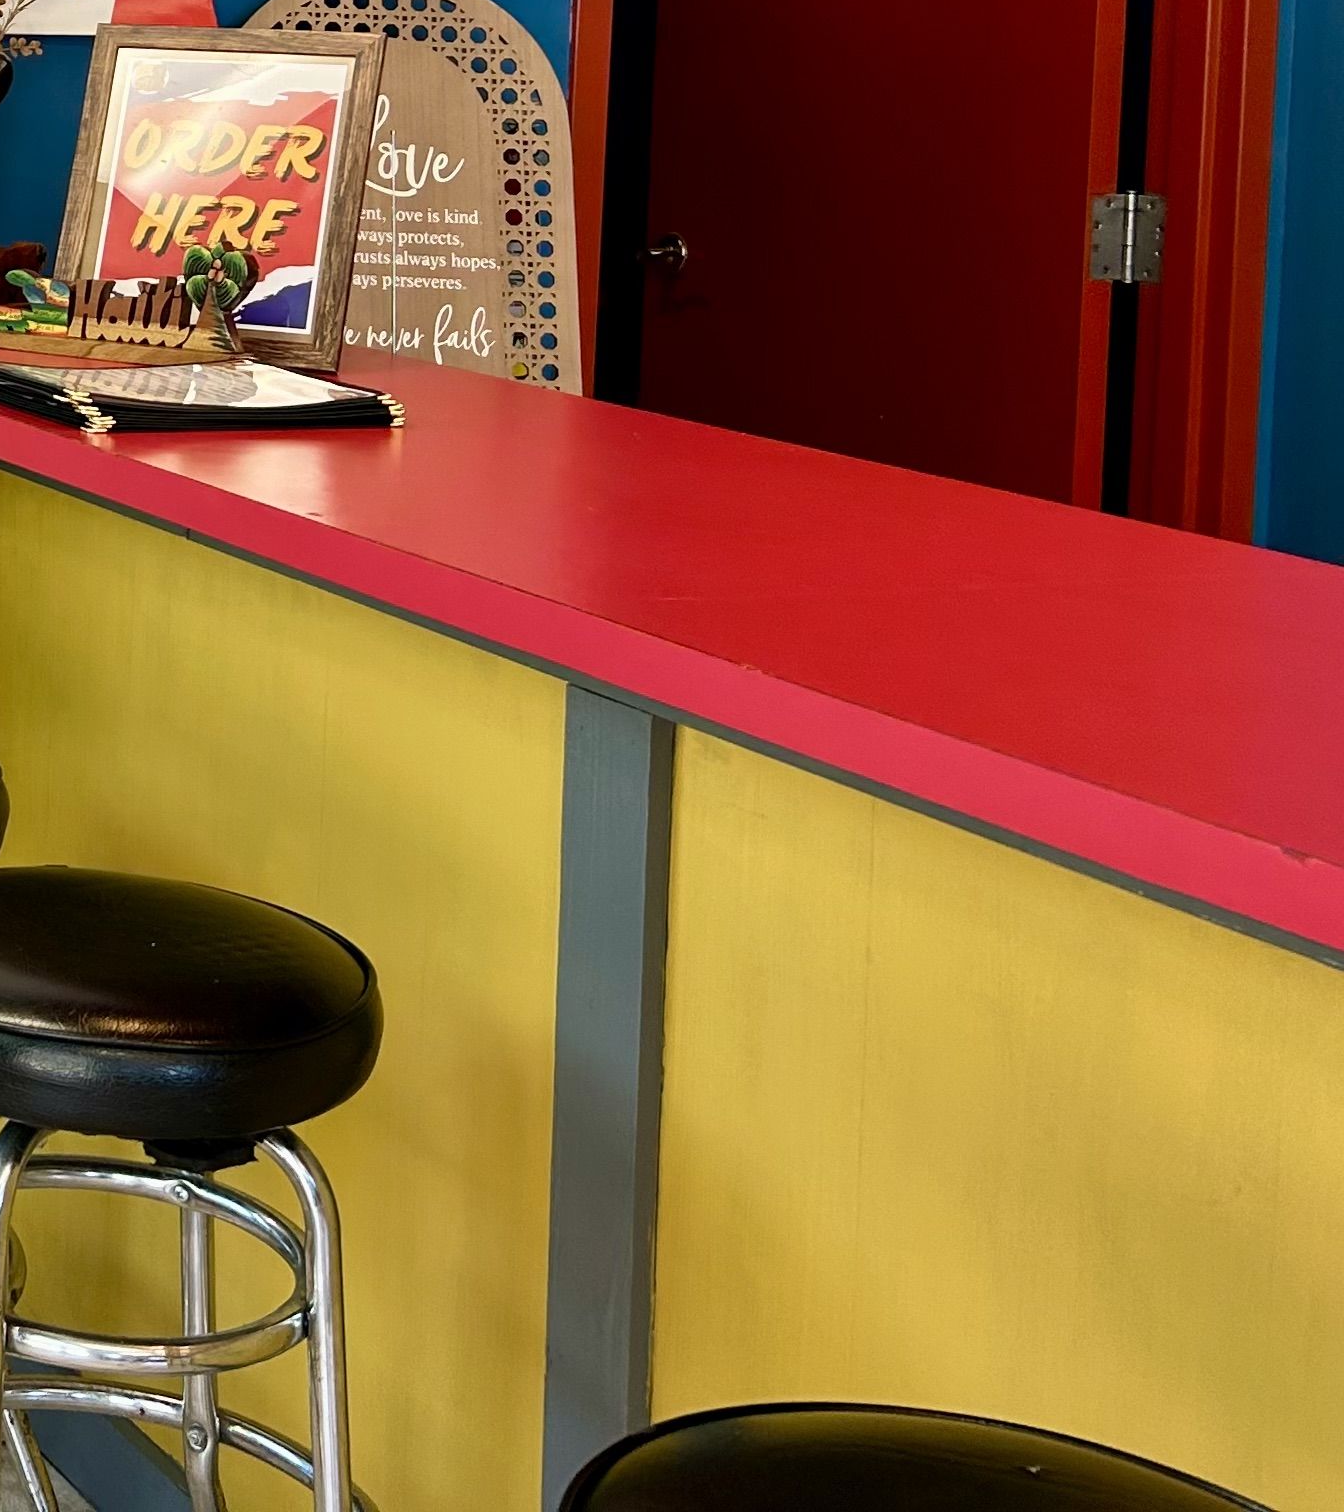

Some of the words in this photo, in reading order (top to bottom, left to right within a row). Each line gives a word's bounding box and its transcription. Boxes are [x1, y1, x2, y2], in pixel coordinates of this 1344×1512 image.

[123, 118, 326, 184] ORDER
[131, 193, 300, 257] HERE
[428, 210, 440, 223] is
[399, 231, 464, 248] protects,
[396, 251, 447, 271] always
[451, 254, 501, 271] hopes,
[382, 275, 466, 290] perseveres.
[433, 304, 496, 365] fails
